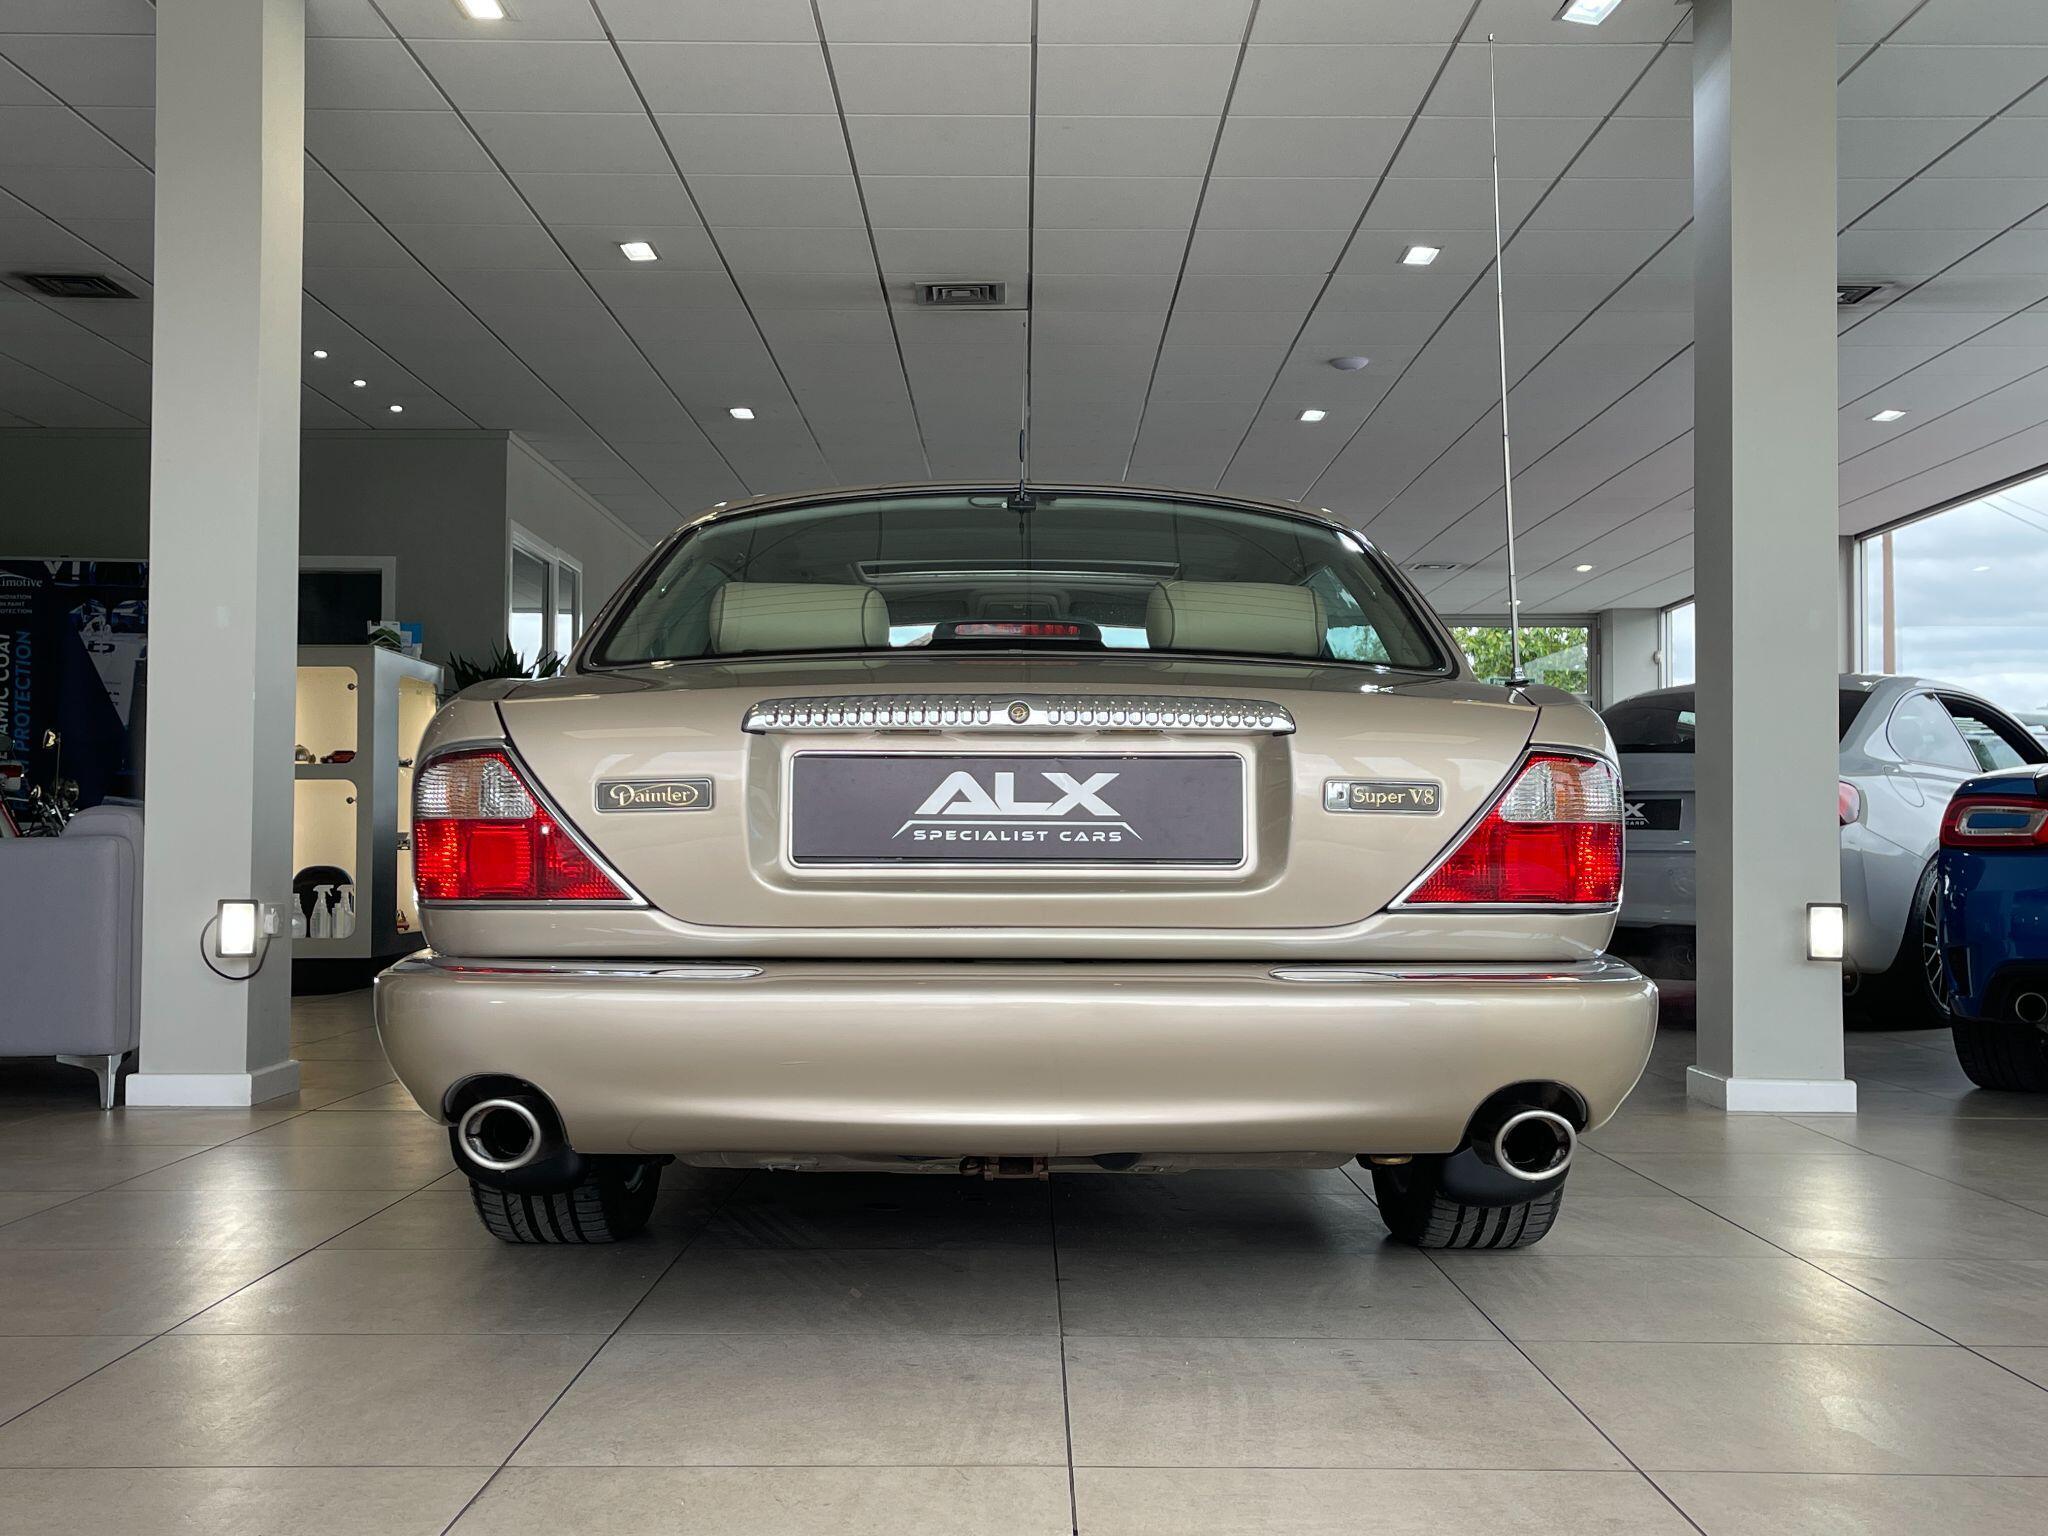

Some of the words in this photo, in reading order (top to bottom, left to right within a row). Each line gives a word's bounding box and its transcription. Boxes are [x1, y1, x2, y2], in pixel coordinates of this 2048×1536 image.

[0, 577, 43, 588] imotive
[14, 631, 31, 751] PROTECTION
[610, 783, 699, 807] Daimler
[914, 770, 1121, 817] ALX
[1352, 787, 1406, 807] Super
[1408, 788, 1435, 805] V8
[913, 830, 1048, 843] SPECIALIST
[1060, 830, 1122, 843] CARS
